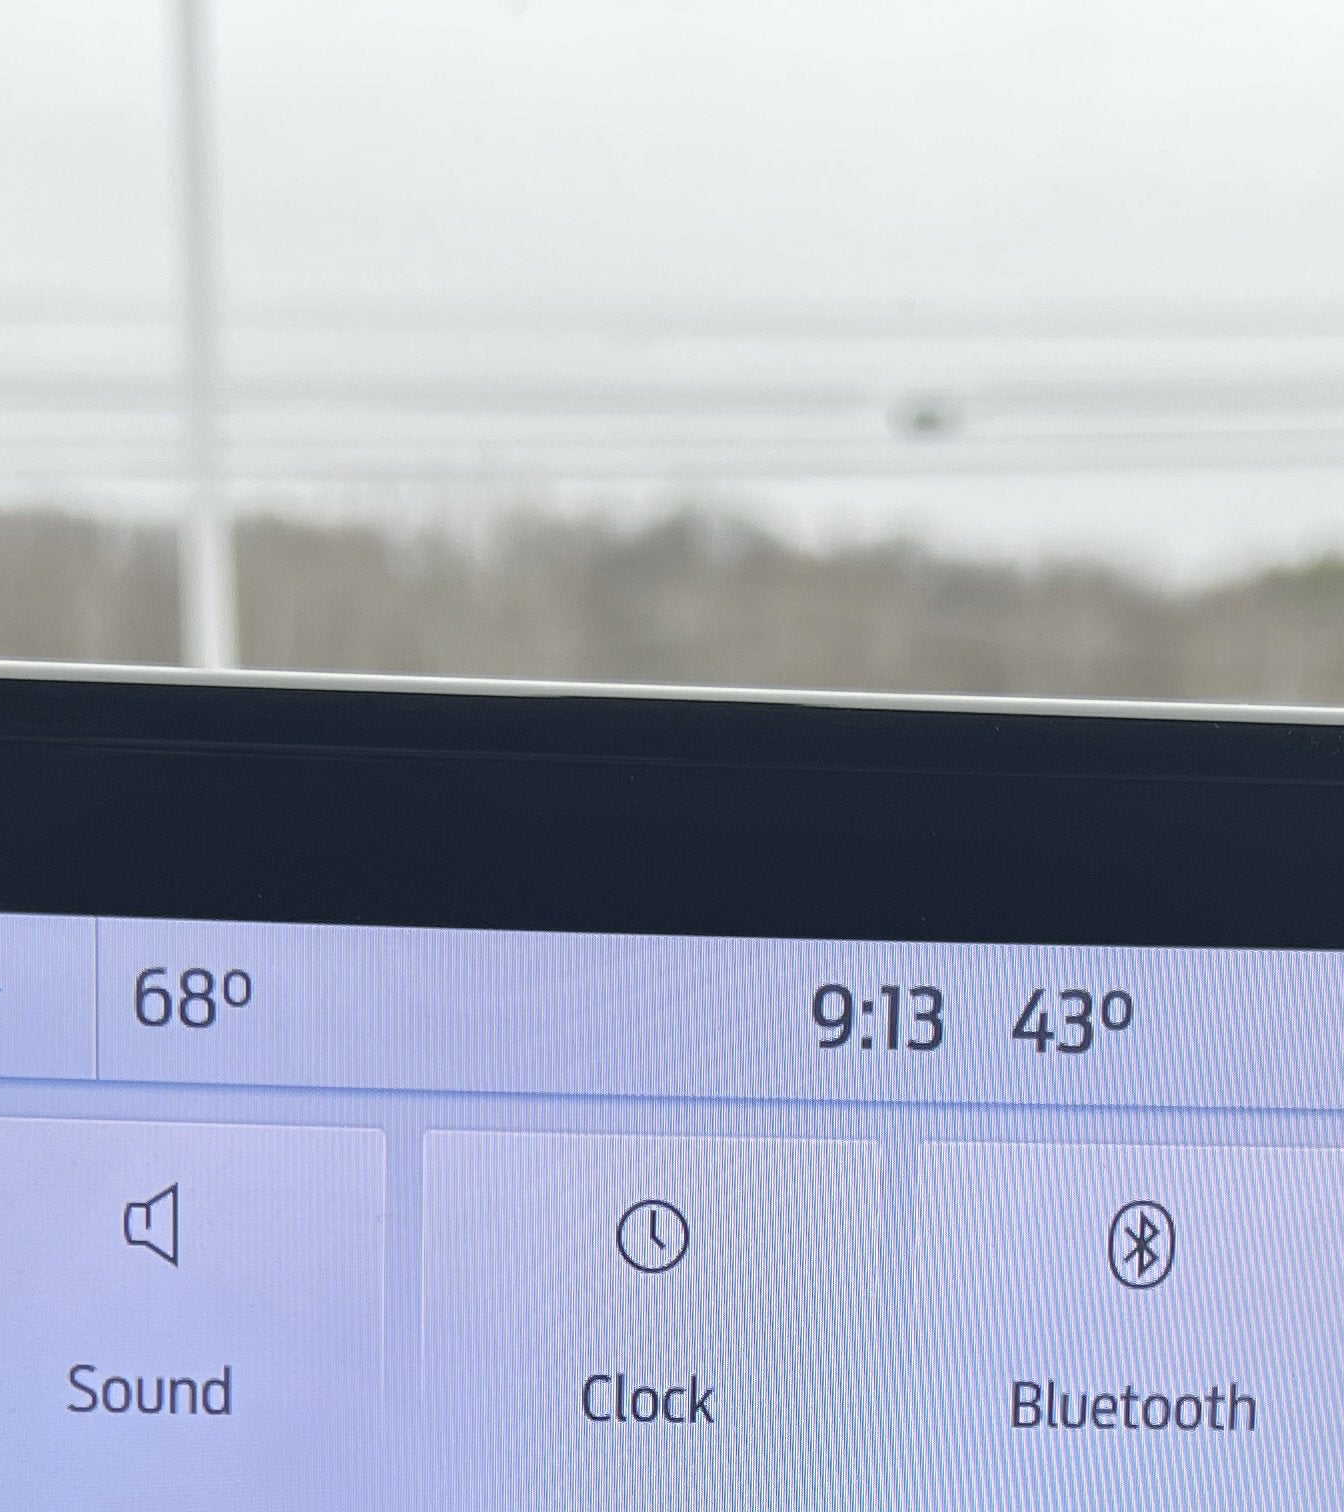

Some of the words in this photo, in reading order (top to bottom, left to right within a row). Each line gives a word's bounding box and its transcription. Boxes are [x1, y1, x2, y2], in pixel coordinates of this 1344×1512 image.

[810, 984, 946, 1052] 9:13
[66, 1364, 234, 1416] Sound
[581, 1373, 715, 1425] Clock
[1010, 1380, 1259, 1435] Bluetooth
